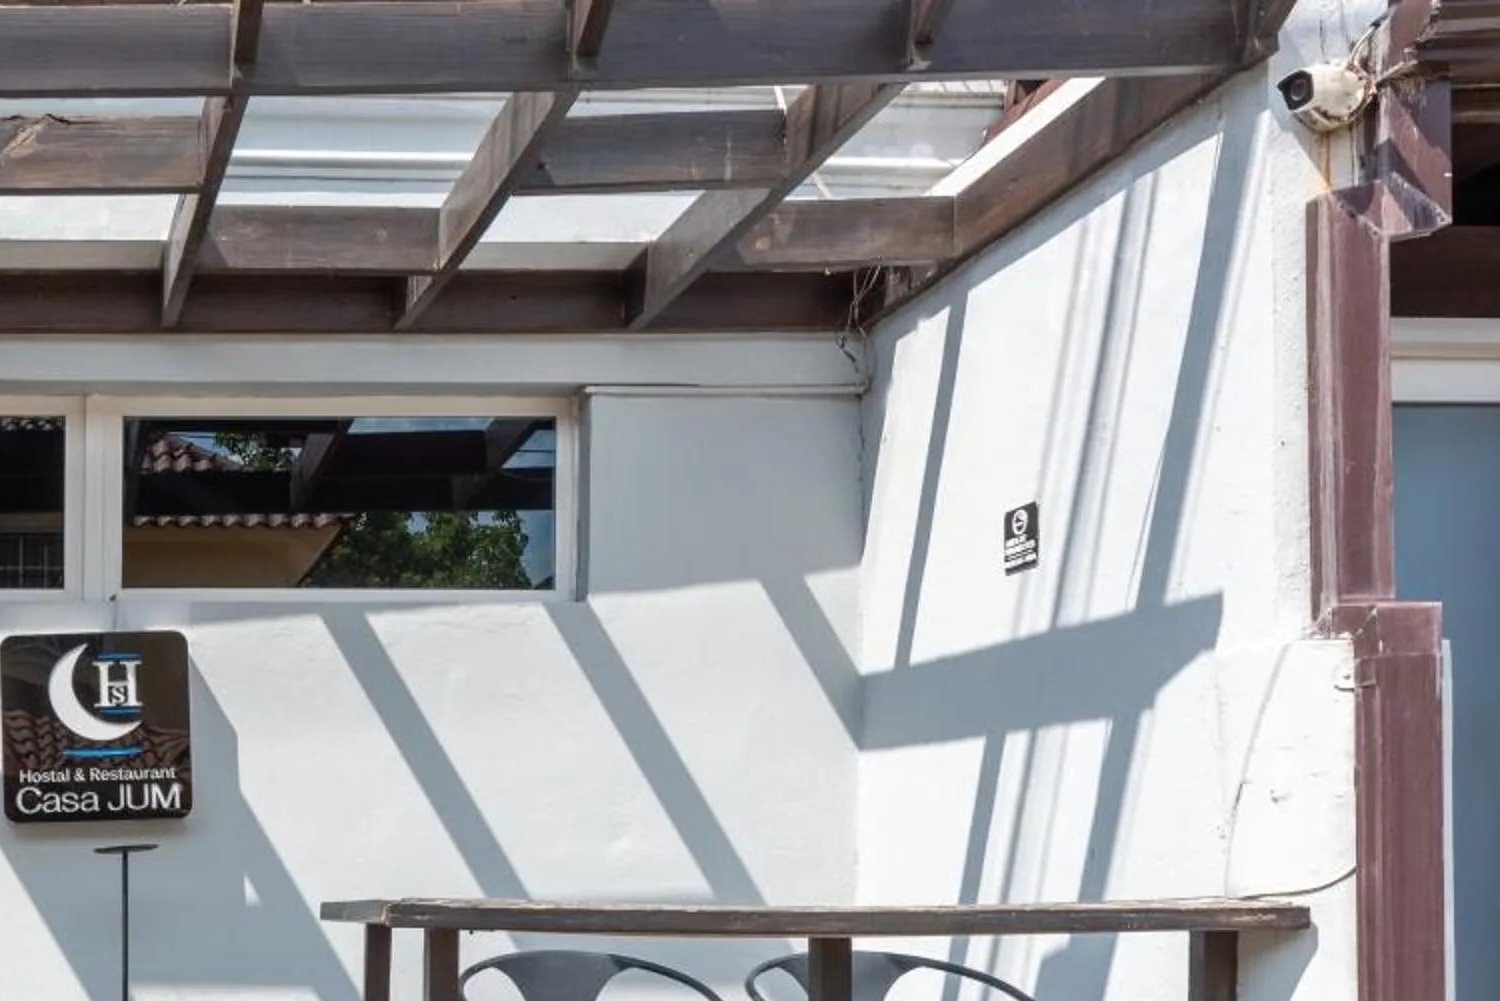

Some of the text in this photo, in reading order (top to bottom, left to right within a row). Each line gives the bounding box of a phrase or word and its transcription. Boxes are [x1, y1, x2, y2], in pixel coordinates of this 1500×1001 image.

[18, 766, 177, 784] Hostal & Restaurant
[15, 782, 183, 815] Casa JUM
